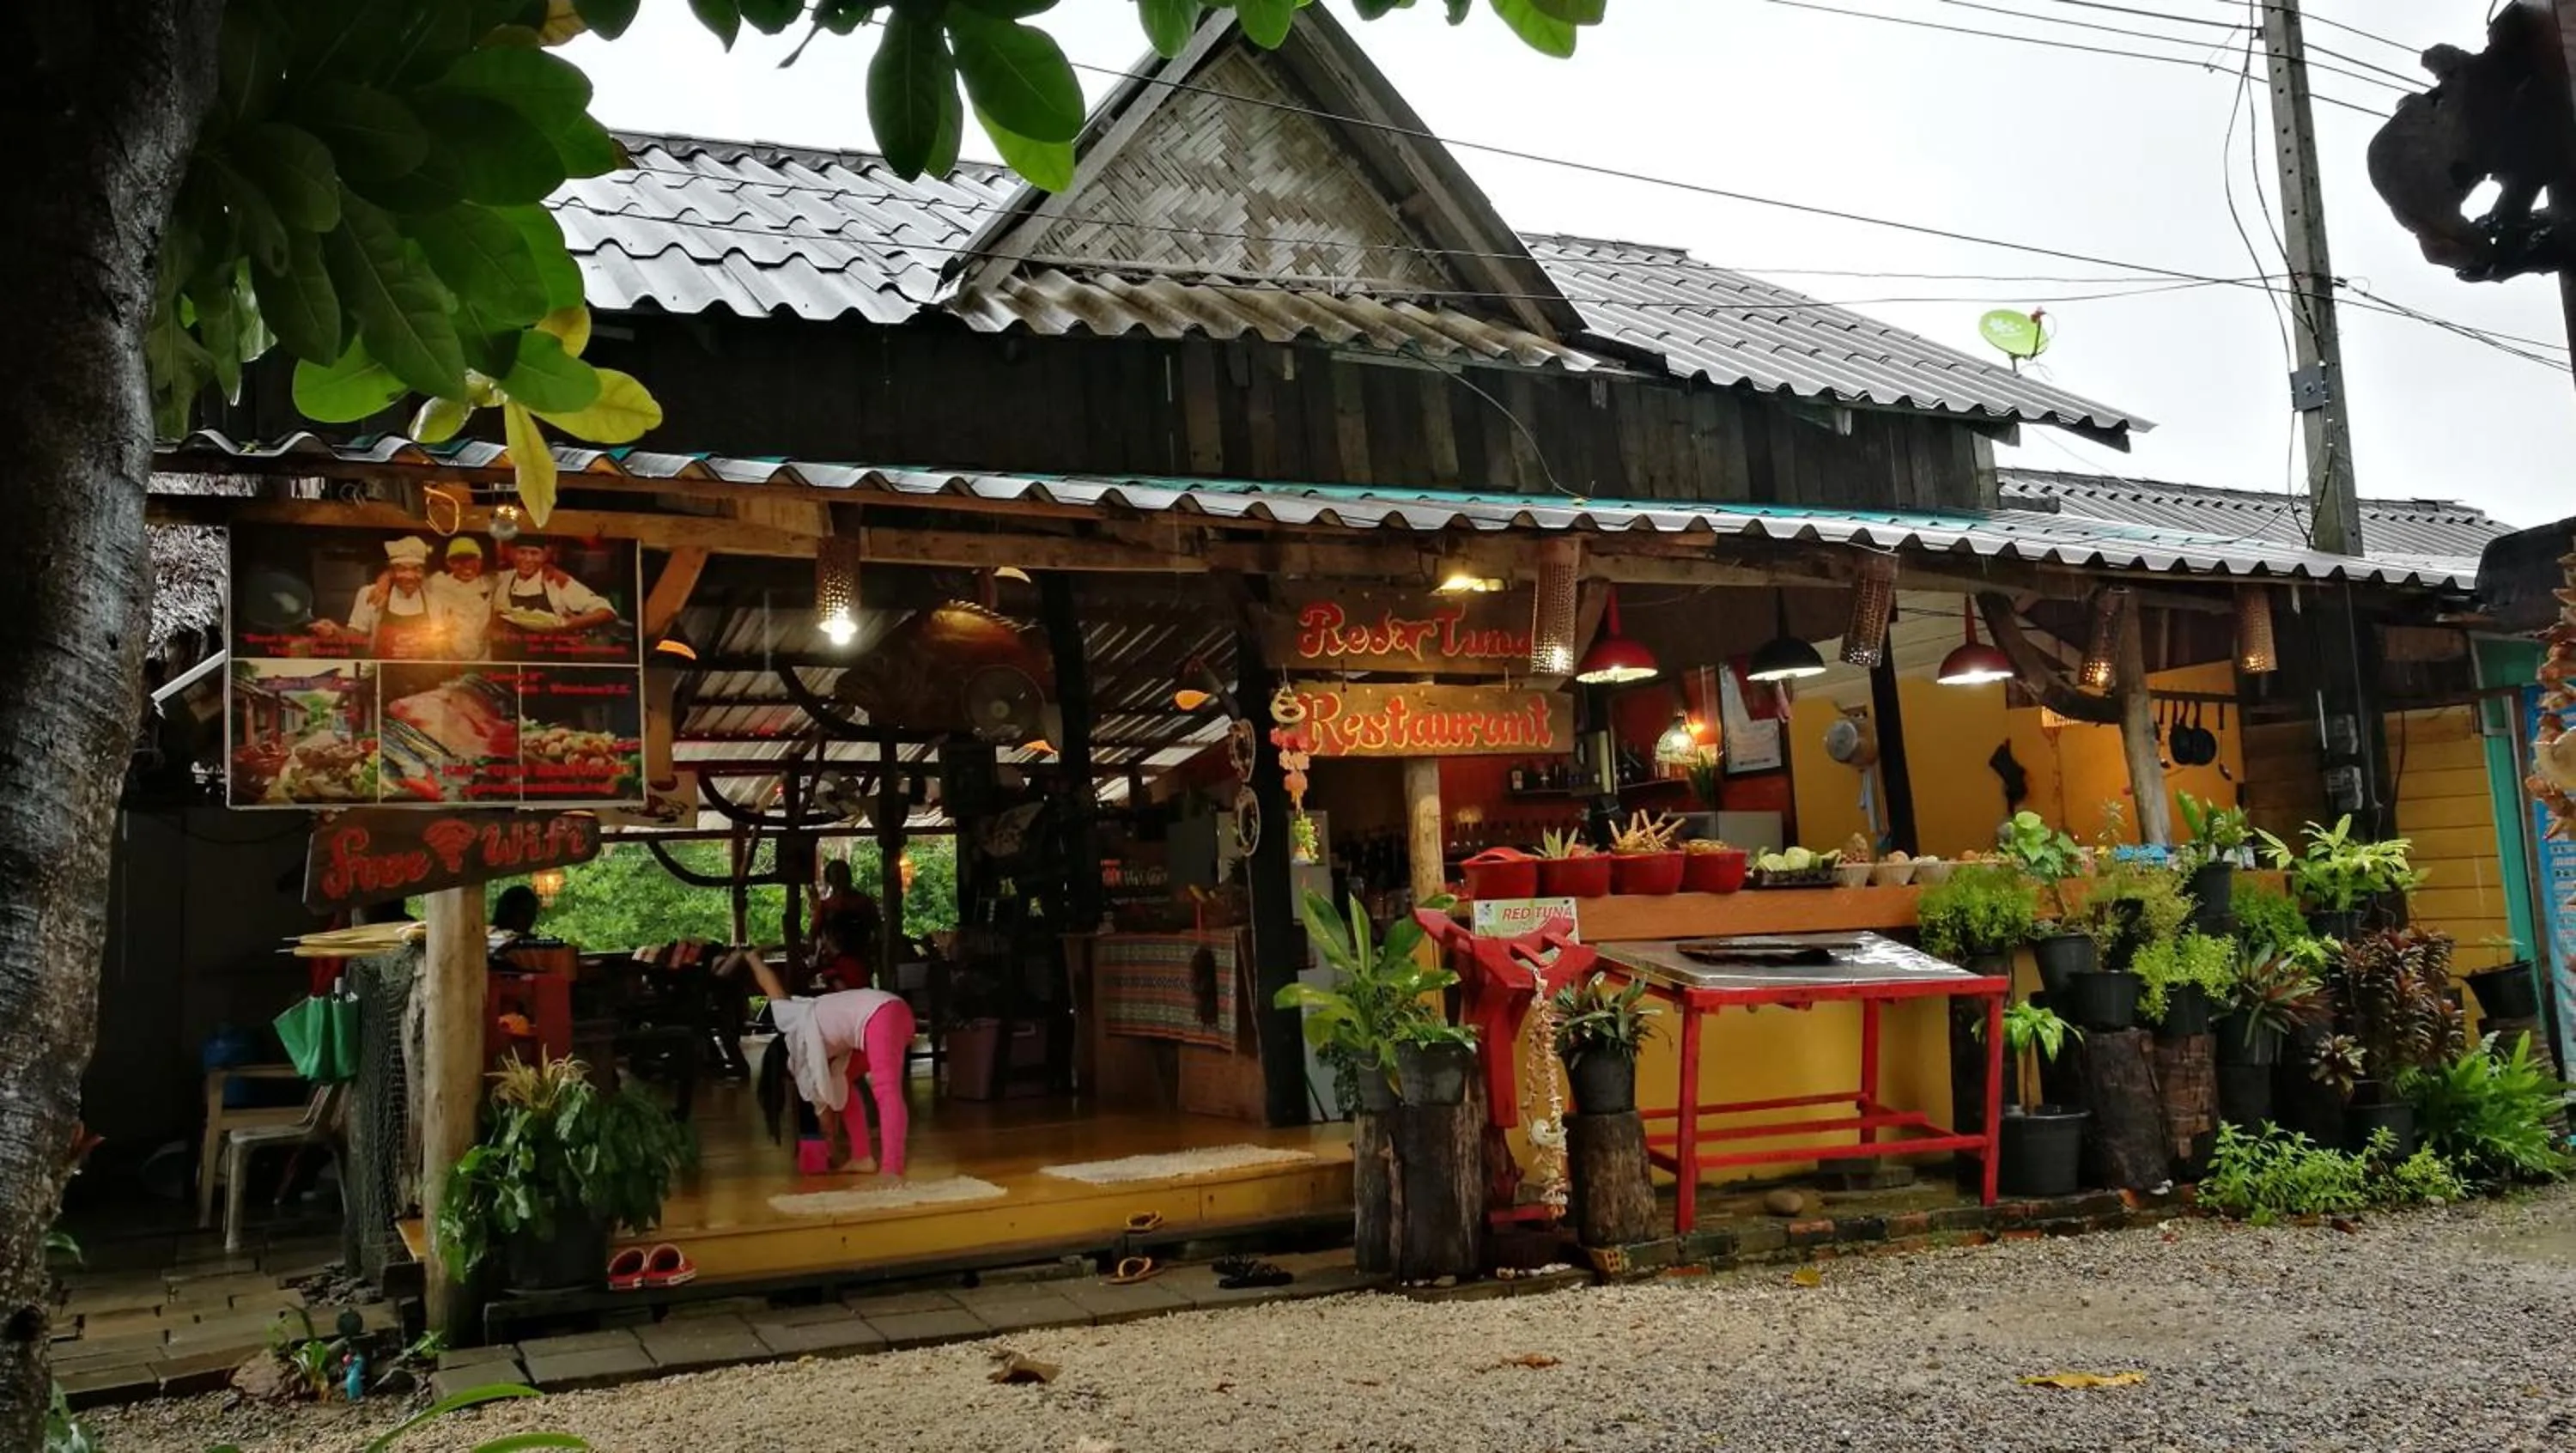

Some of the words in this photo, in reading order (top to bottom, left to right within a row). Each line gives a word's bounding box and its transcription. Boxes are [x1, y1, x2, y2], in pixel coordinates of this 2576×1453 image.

[1296, 691, 1554, 757] Restaurant
[321, 826, 431, 899] Free
[1503, 908, 1531, 921] RED
